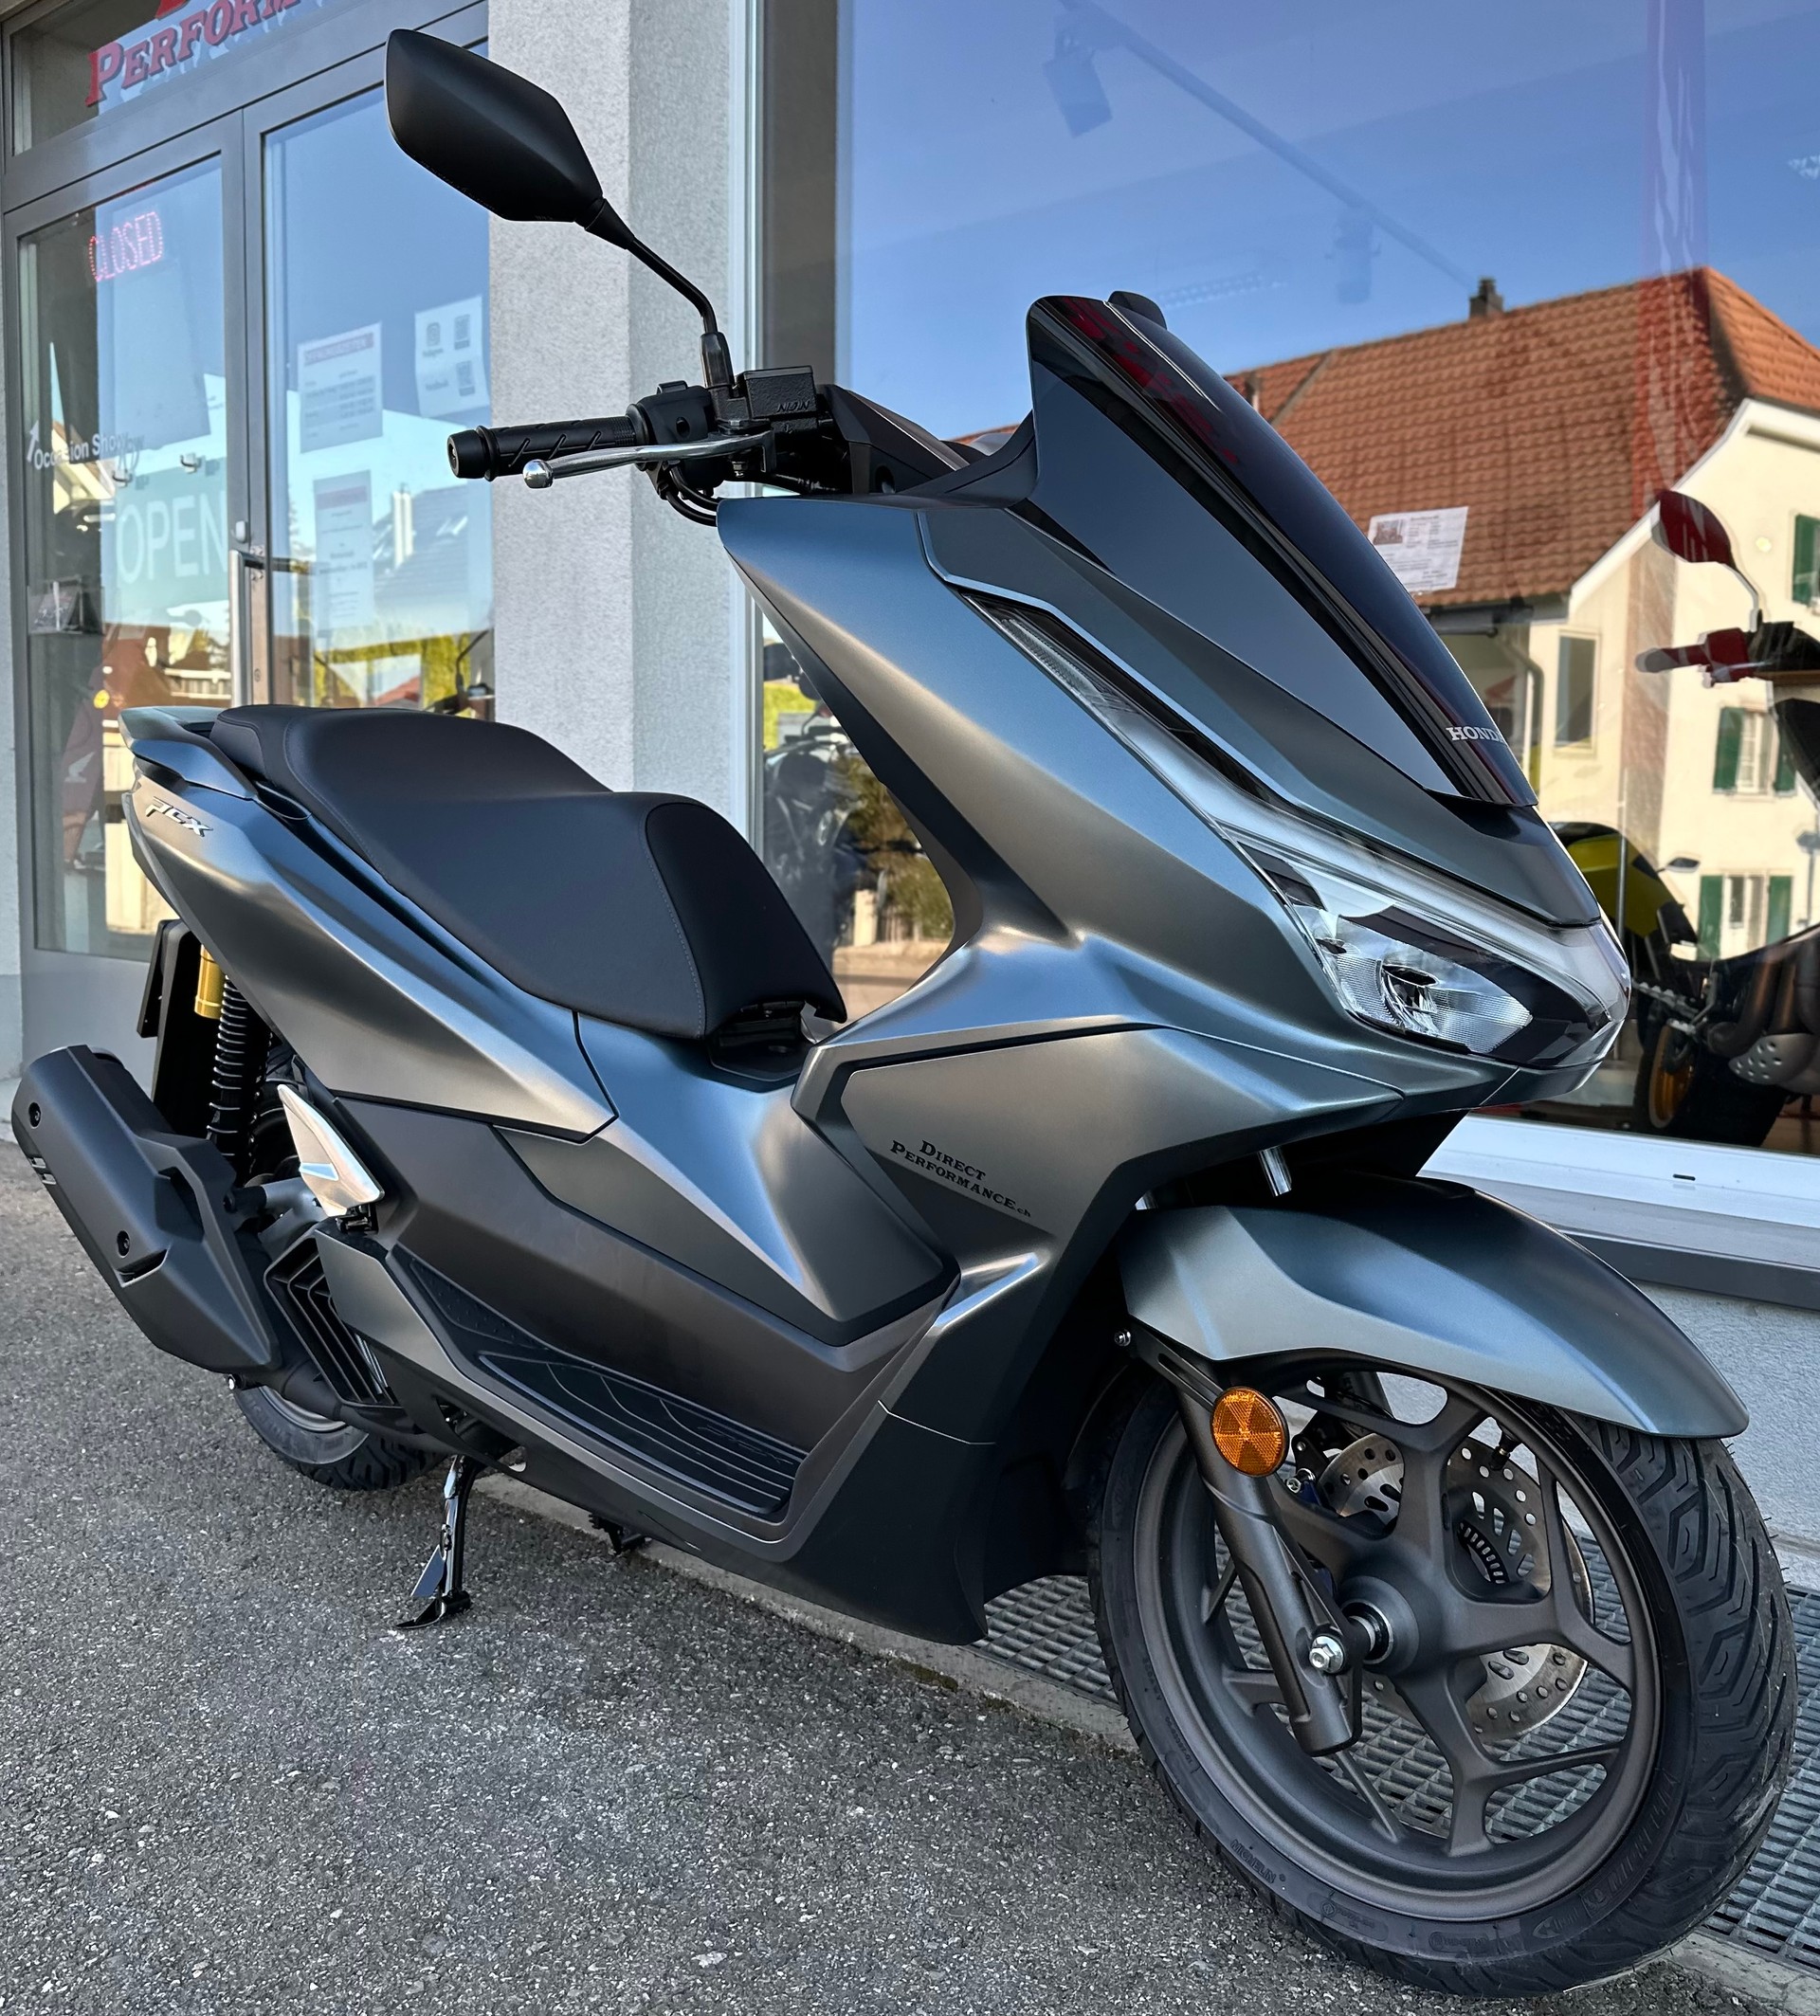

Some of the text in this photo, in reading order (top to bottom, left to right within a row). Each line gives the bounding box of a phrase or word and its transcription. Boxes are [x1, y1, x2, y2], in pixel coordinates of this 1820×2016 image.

[88, 211, 163, 282] CLOSED
[116, 490, 228, 584] OPEN
[145, 795, 214, 837] PCX
[889, 1139, 1031, 1218] PERFORMANCE.ch
[919, 1139, 987, 1181] DIRECT
